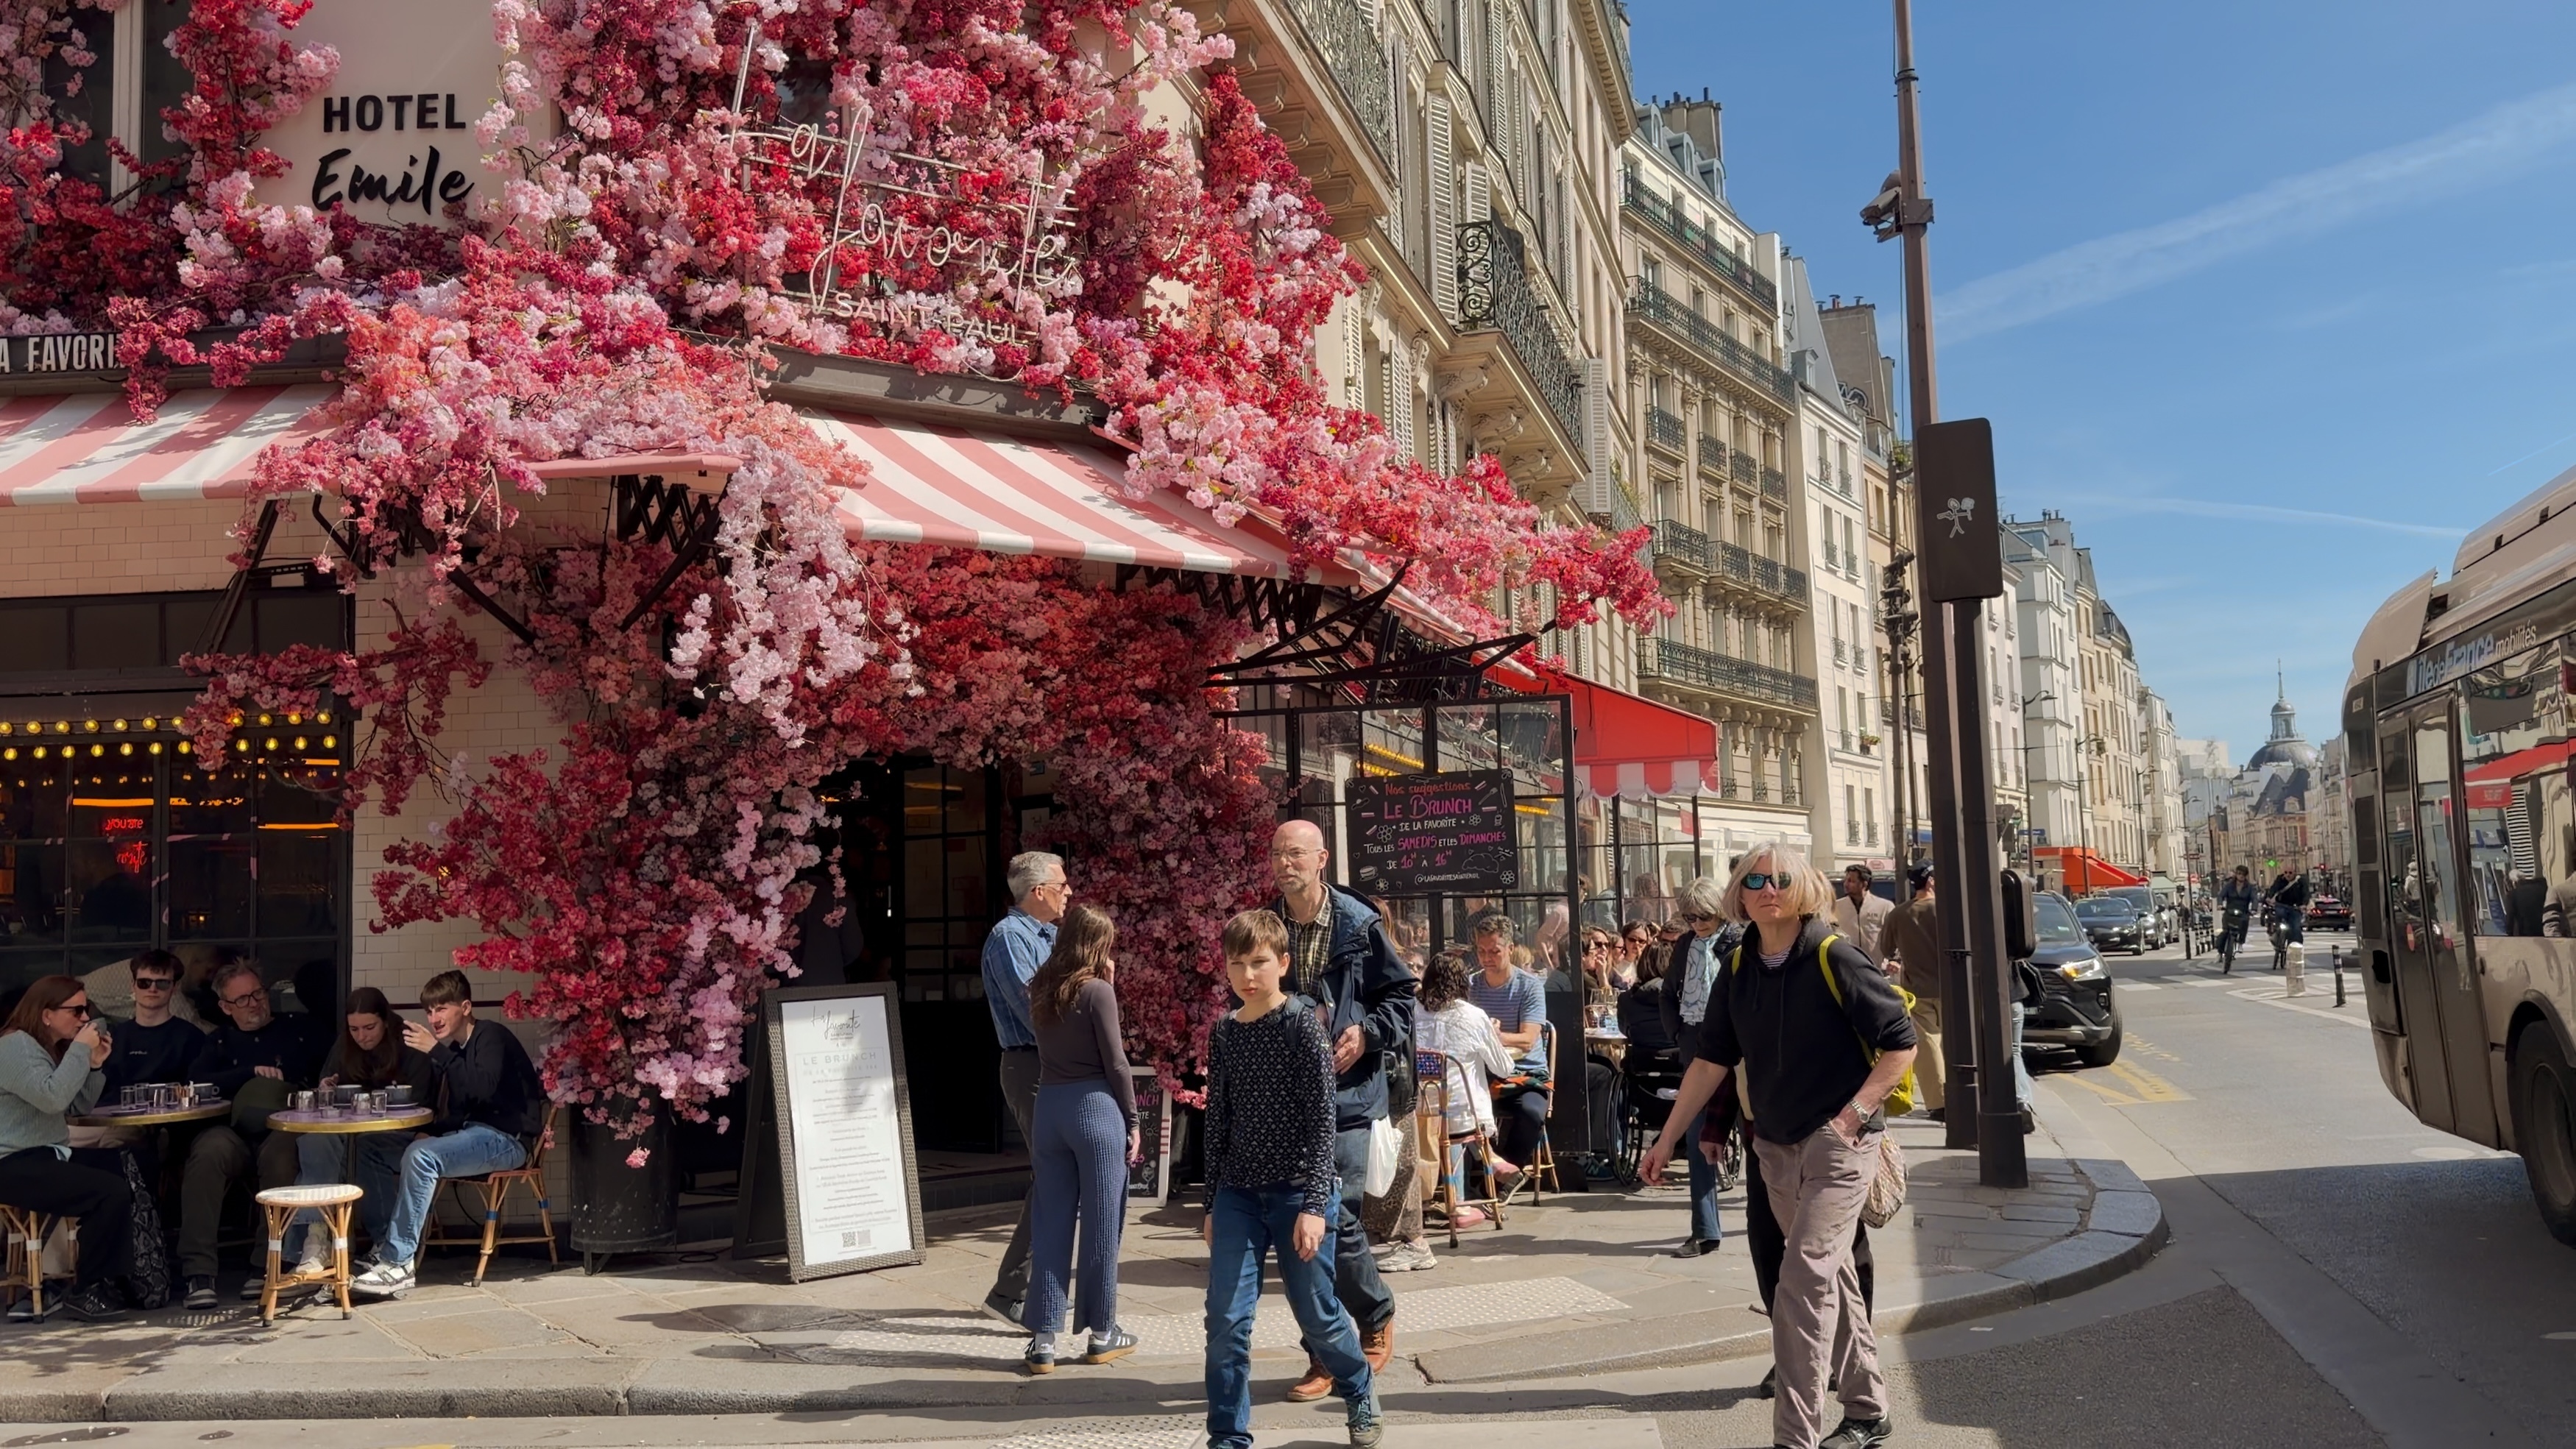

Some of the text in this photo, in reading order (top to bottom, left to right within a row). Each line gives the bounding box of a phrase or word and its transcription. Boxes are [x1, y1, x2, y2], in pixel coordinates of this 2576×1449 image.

[324, 94, 466, 132] HOTEL
[312, 145, 475, 216] Emile
[28, 333, 125, 372] FAVORI
[2444, 633, 2494, 679] France
[2495, 619, 2537, 659] mobilités
[1385, 782, 1471, 797] Nos suggestions
[1384, 794, 1472, 819] LE BRUNCH
[1399, 817, 1457, 832] DE LA FAVORITE
[1384, 844, 1395, 853] LES
[1398, 832, 1437, 851] SAMEDIS
[1459, 831, 1507, 846] DIMANCHES
[1387, 860, 1398, 870] DE
[803, 1052, 877, 1066] LE BRUNCH
